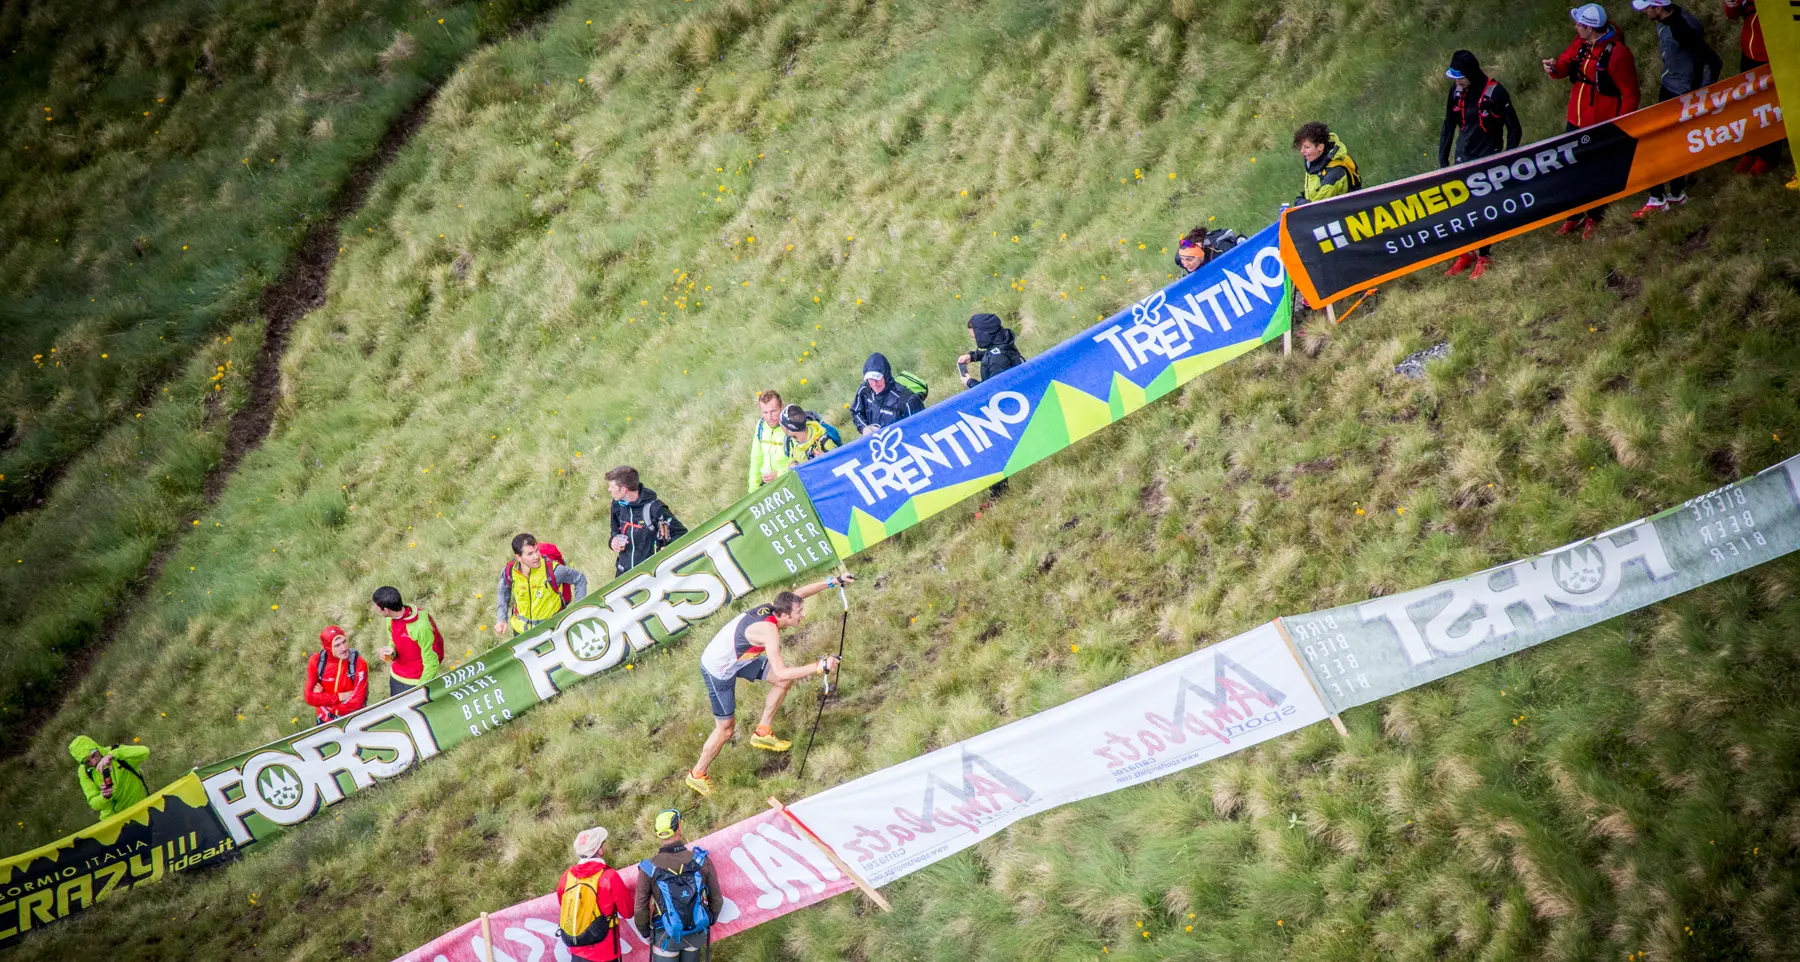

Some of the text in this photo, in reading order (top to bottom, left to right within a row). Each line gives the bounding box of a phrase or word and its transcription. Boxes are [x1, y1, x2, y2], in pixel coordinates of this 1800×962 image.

[1679, 72, 1772, 122] Hydr
[1687, 103, 1783, 153] Stay Tr
[1385, 192, 1536, 254] SUPERFOOD
[1093, 246, 1284, 371] TRENTINO
[832, 390, 1030, 506] TRENTINO
[749, 487, 795, 520] BIRRA
[759, 504, 808, 537] BIÈRE
[771, 522, 820, 555] BEER
[784, 540, 832, 573] BIER
[512, 520, 757, 701] FORST
[442, 661, 485, 688] BIRRA
[449, 675, 497, 700] BIÈRE
[462, 688, 505, 720] BEER
[202, 687, 440, 847] FORST
[86, 840, 148, 869] ITALIA
[169, 837, 234, 873] idea.it
